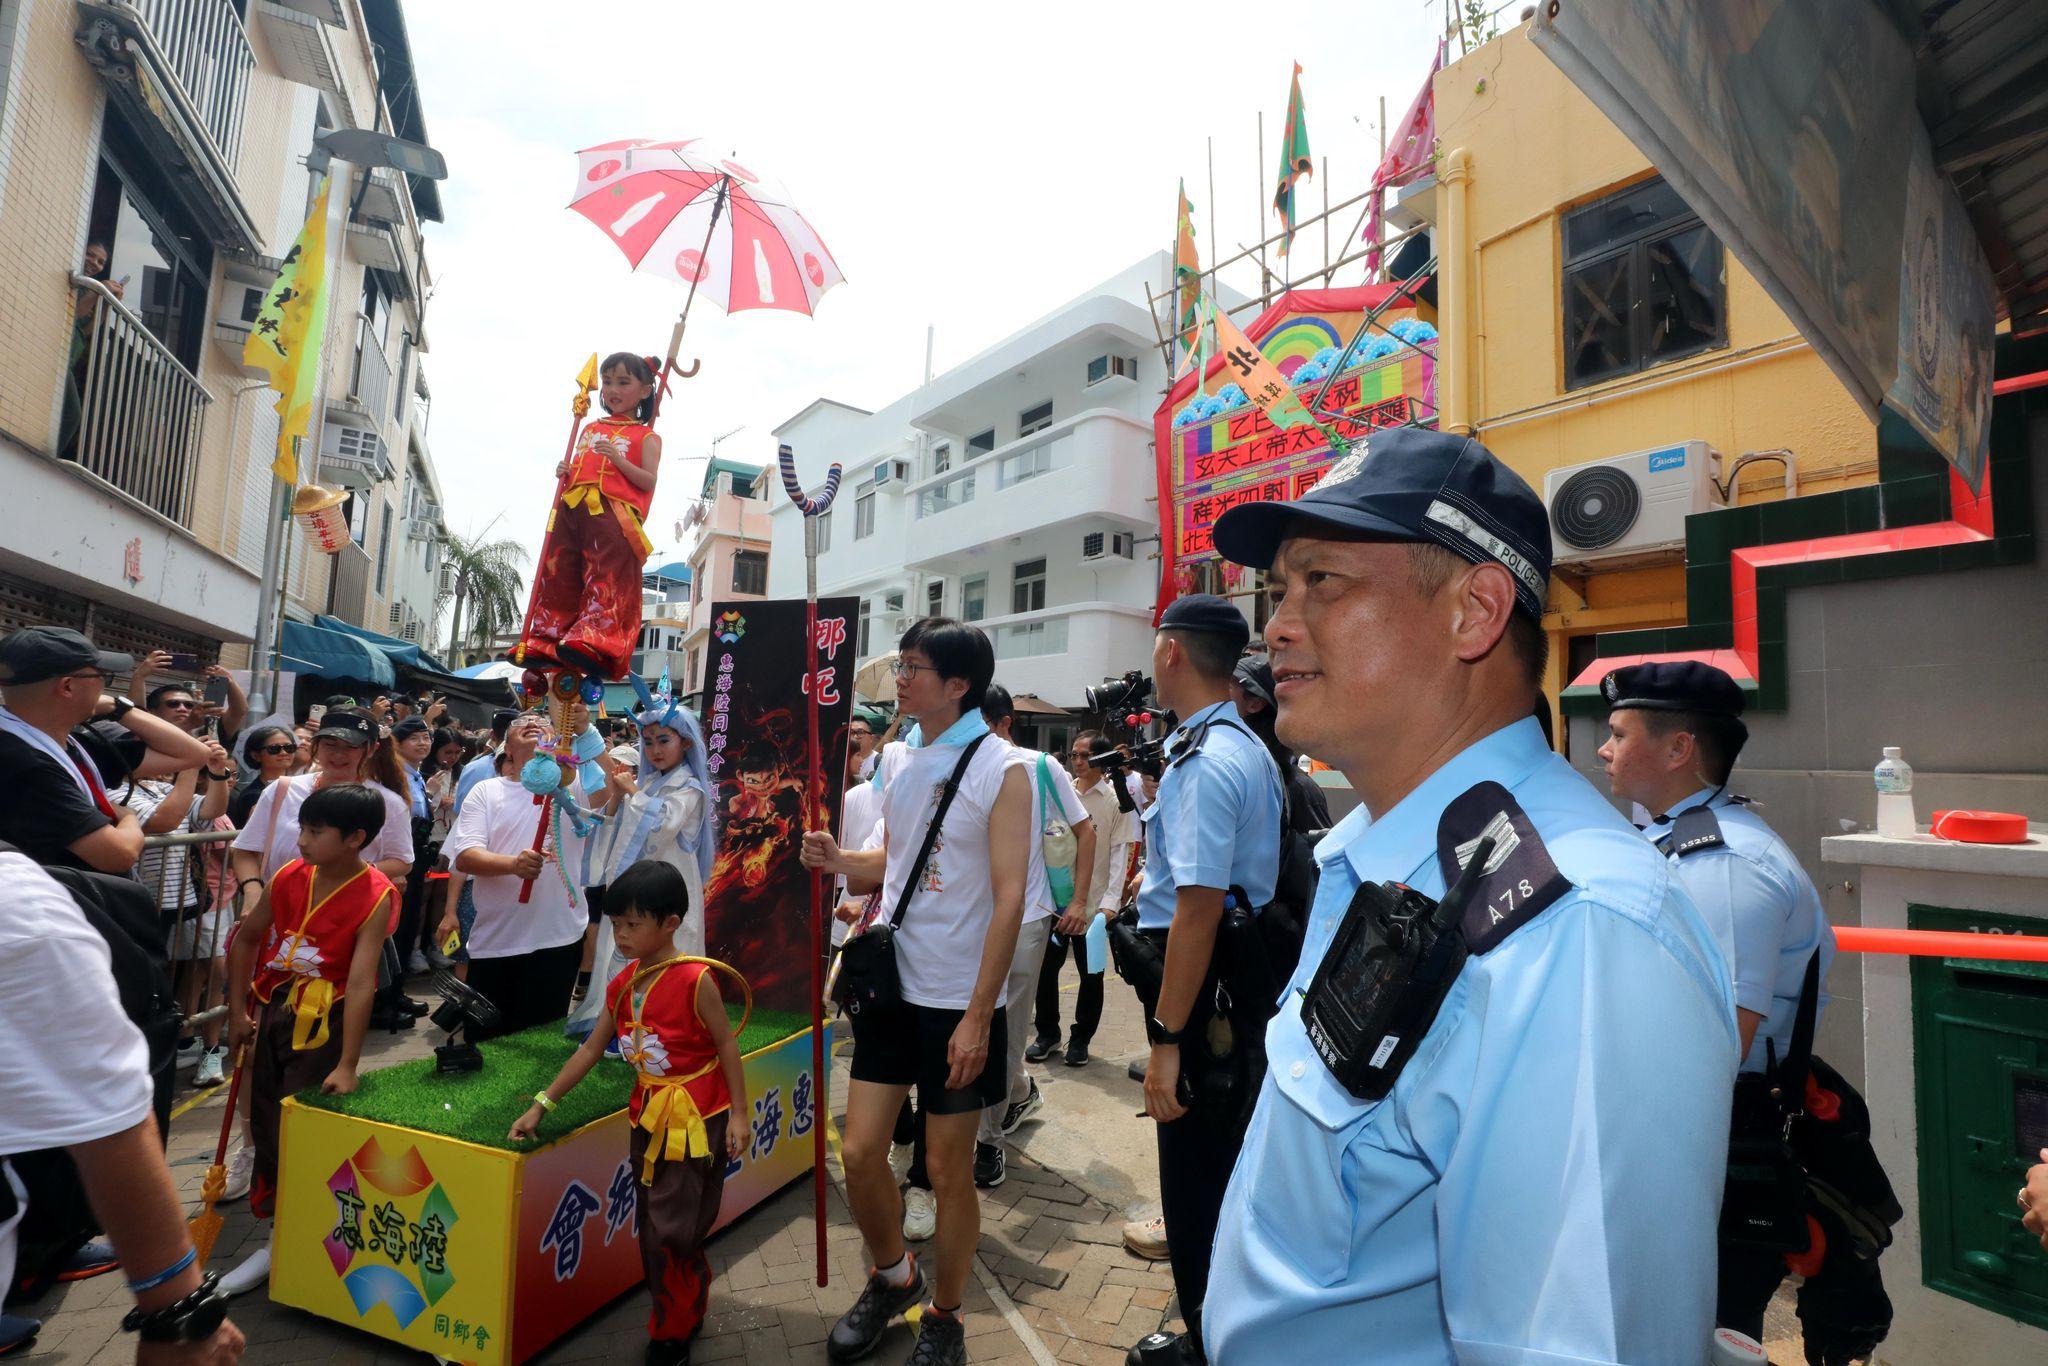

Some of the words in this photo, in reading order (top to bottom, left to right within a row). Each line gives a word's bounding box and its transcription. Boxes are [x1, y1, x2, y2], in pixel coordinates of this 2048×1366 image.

[1228, 346, 1260, 377] 北
[1500, 546, 1538, 586] POLICE
[706, 653, 735, 774] 惠海陸同鄉會
[1488, 878, 1534, 925] A78
[332, 1187, 449, 1274] 惠海陸
[434, 1313, 491, 1351] 同鄉會
